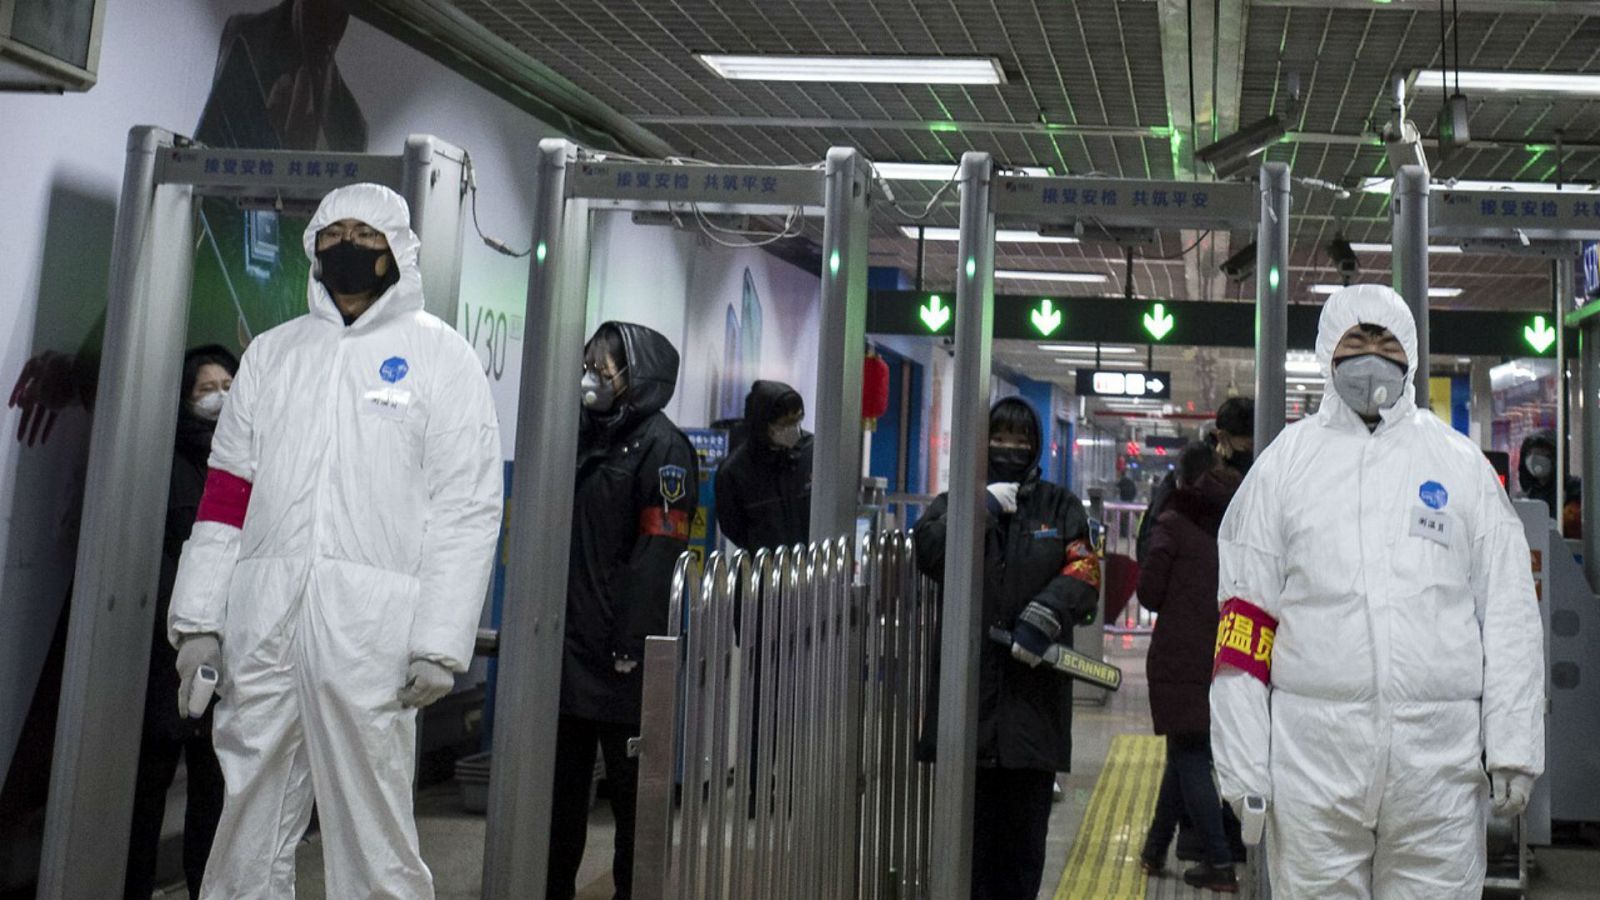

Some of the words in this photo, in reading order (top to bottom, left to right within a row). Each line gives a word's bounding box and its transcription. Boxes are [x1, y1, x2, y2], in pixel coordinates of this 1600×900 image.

[204, 157, 274, 175] 接受安检
[288, 160, 359, 178] 共筑平安
[616, 171, 689, 189] 接受安检
[704, 173, 777, 193] 共筑平安
[1042, 187, 1117, 206] 接受安检
[1132, 190, 1209, 207] 共筑平安
[1481, 199, 1558, 217] 接受安检
[465, 302, 507, 381] V30
[1214, 611, 1275, 669] 温员
[1063, 654, 1116, 682] SCANNER
